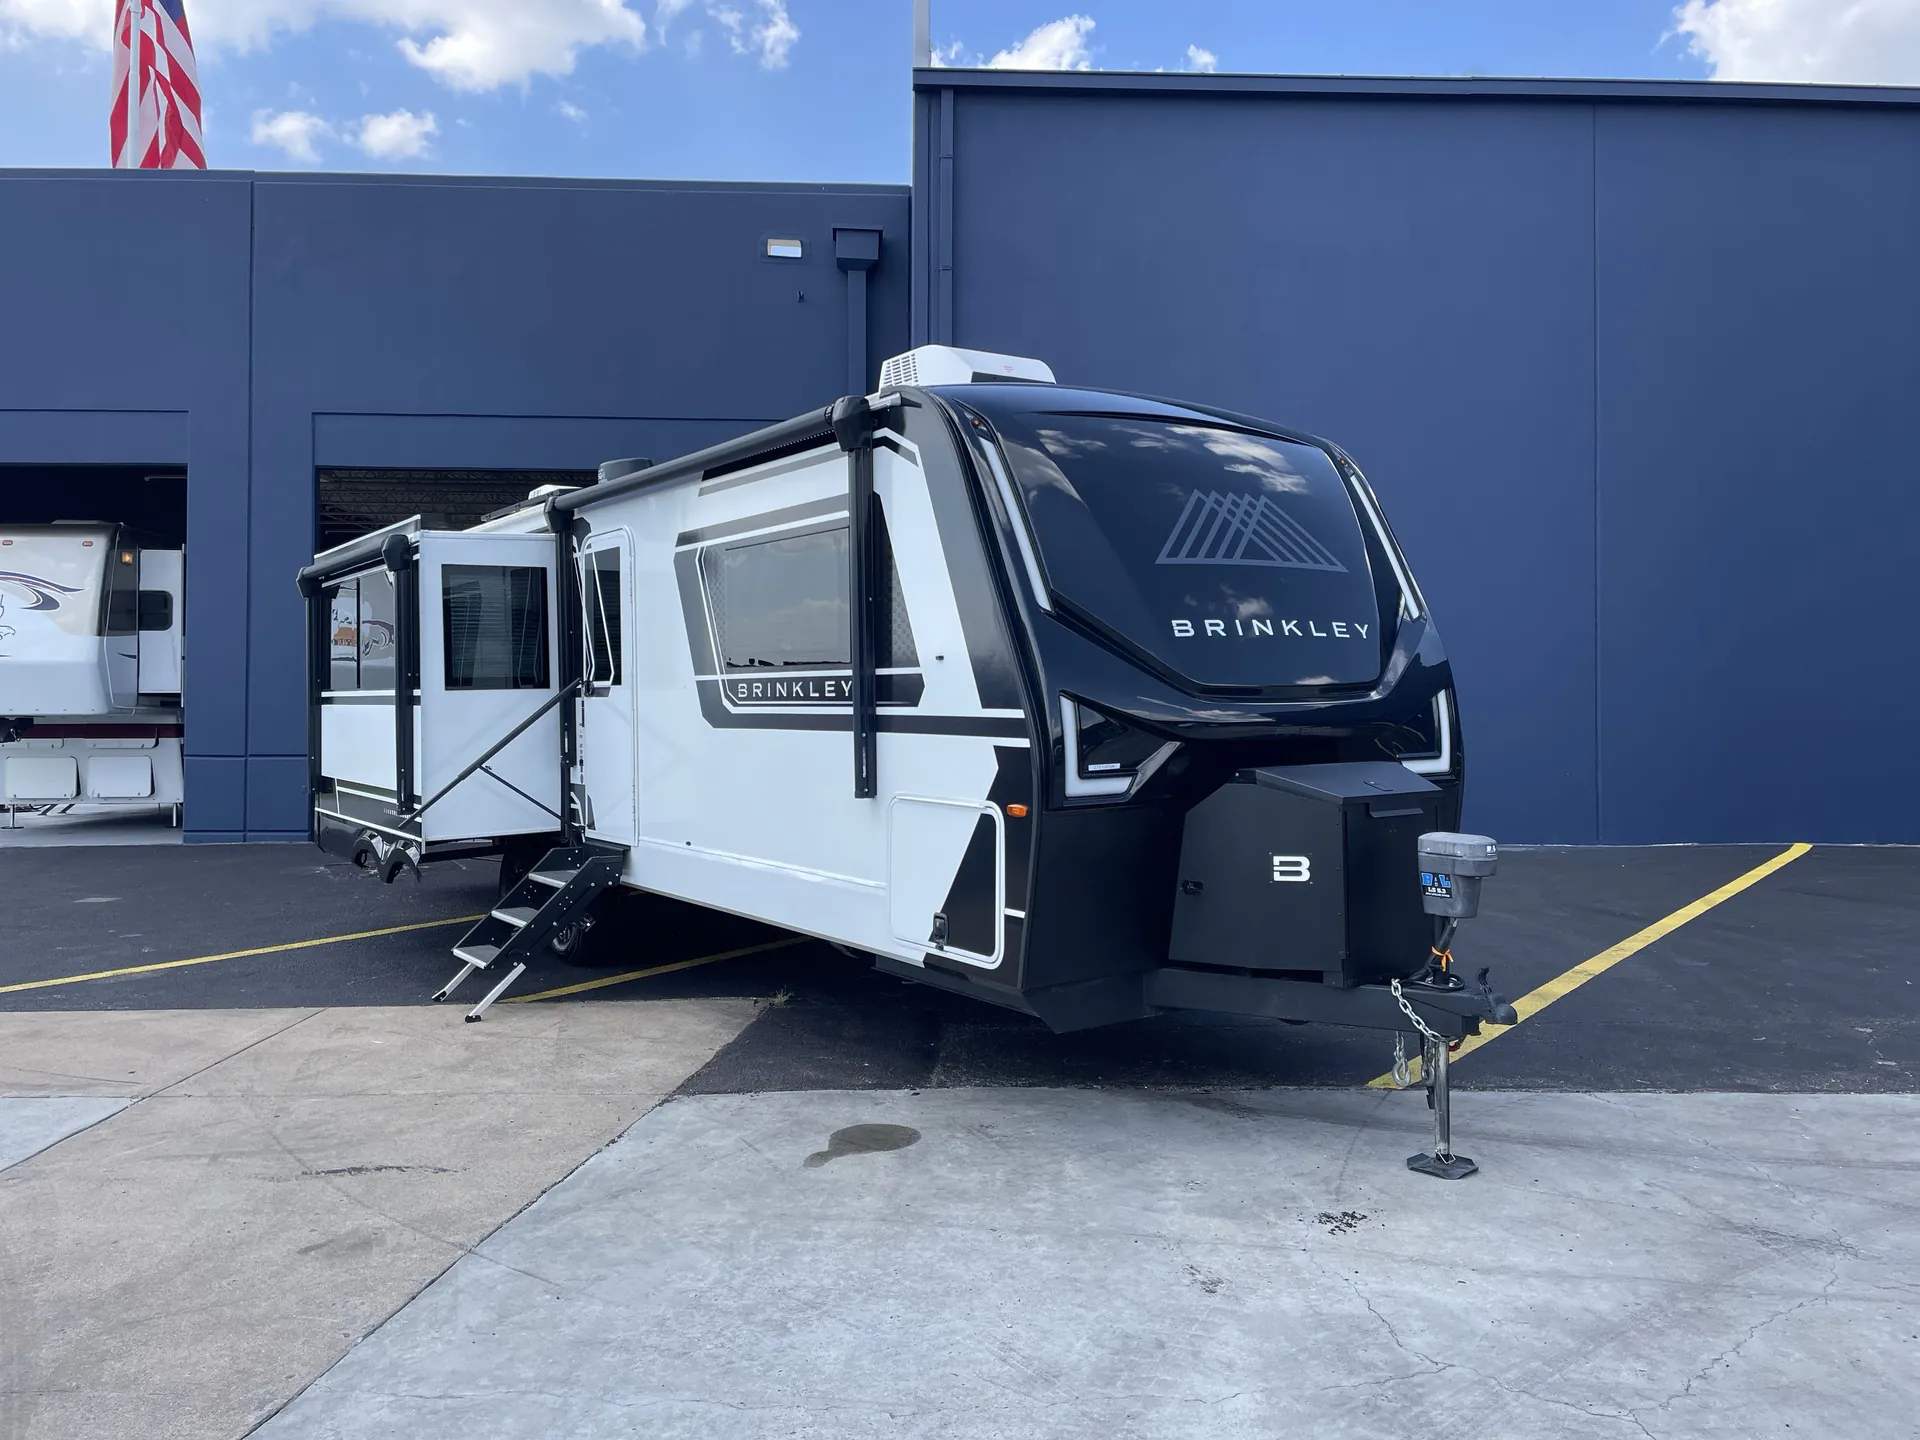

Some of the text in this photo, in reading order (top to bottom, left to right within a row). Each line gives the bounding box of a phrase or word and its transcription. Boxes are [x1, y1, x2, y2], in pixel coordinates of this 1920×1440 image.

[1171, 619, 1369, 639] BRINKLEY
[738, 680, 853, 698] BRINKLEY
[1273, 856, 1311, 881] B
